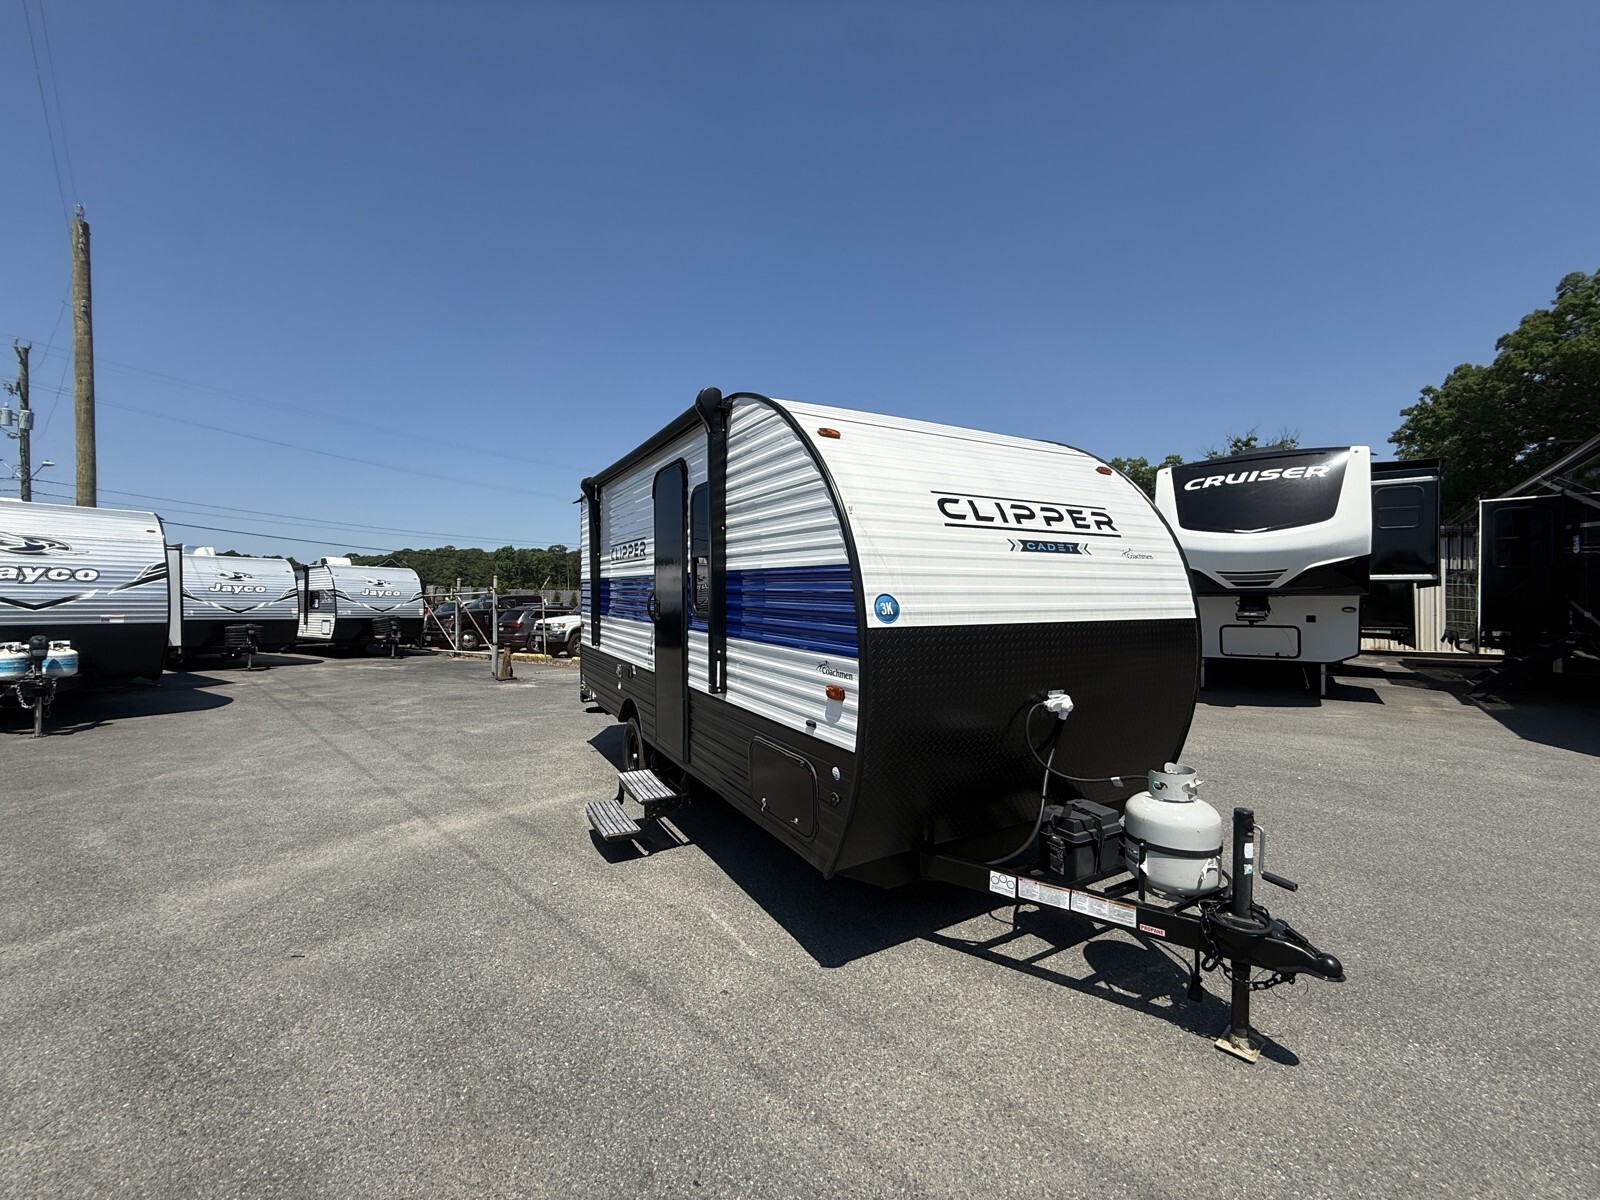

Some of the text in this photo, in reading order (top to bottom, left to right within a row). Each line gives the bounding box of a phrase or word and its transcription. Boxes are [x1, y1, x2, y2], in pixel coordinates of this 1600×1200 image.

[1184, 465, 1331, 491] CRUISER
[936, 497, 1119, 532] CLIPPER
[610, 541, 646, 561] CLIPPER
[1026, 541, 1075, 553] CADET
[0, 565, 101, 584] ayco
[209, 582, 267, 595] Jayco
[361, 588, 401, 598] Jayco
[880, 601, 894, 616] 3K
[821, 665, 853, 681] Coachmen
[1140, 924, 1165, 936] PROPANE
